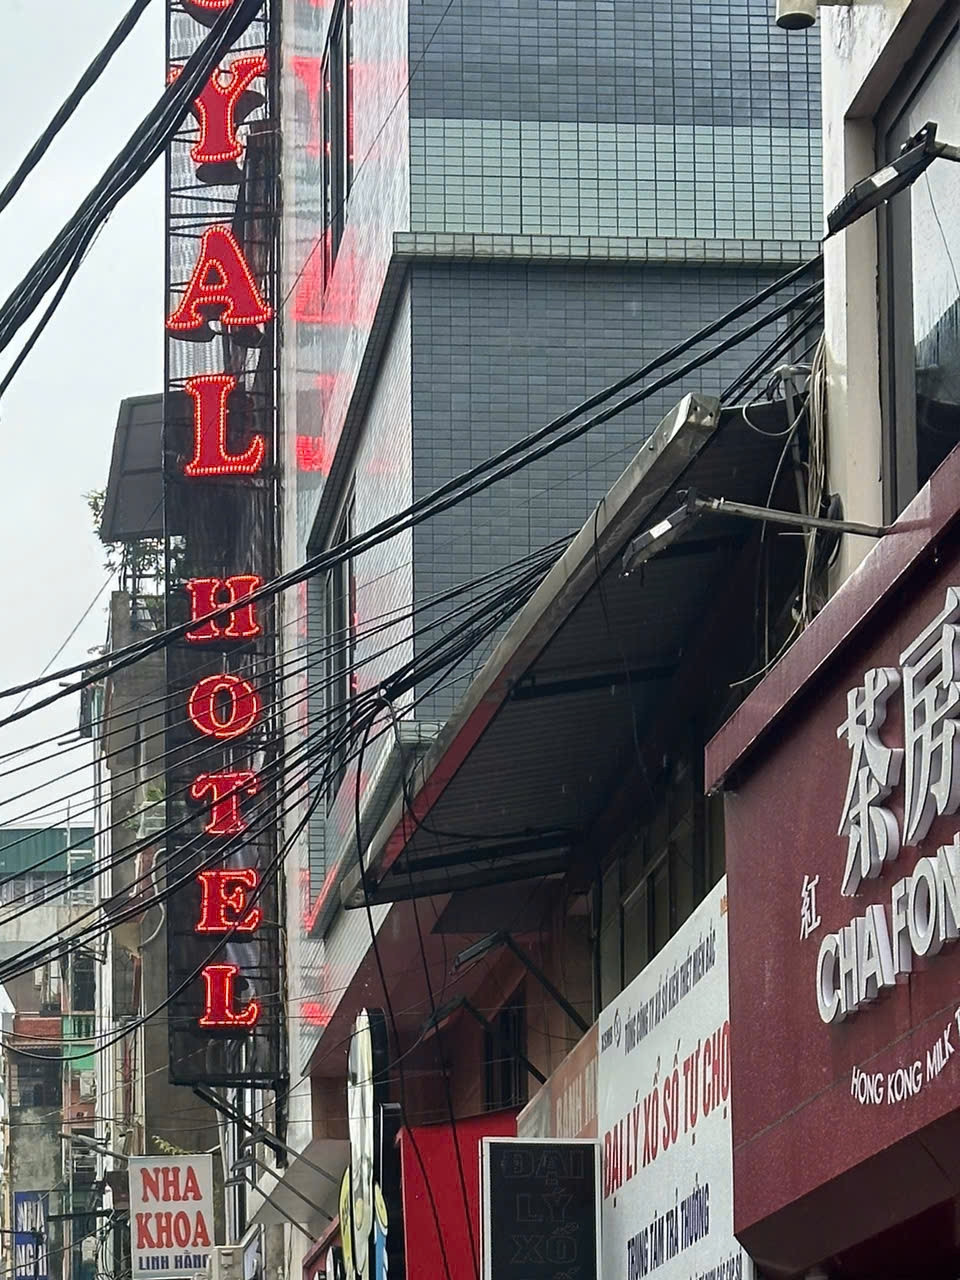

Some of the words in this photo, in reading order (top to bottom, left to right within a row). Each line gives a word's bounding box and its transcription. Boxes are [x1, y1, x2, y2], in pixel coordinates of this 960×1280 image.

[185, 575, 262, 1027] HOTEL
[851, 1066, 883, 1104] HONG
[887, 1060, 922, 1105] KONG
[926, 1022, 955, 1083] MILK
[626, 1089, 640, 1182] LÝ
[643, 1056, 660, 1168] XỔ
[663, 1039, 681, 1151] SỐ
[683, 1038, 701, 1146] TỰ
[703, 1020, 730, 1119] CHỌ
[140, 1167, 203, 1202] NHA
[136, 1210, 211, 1249] KHOA
[139, 1255, 169, 1270] LINH
